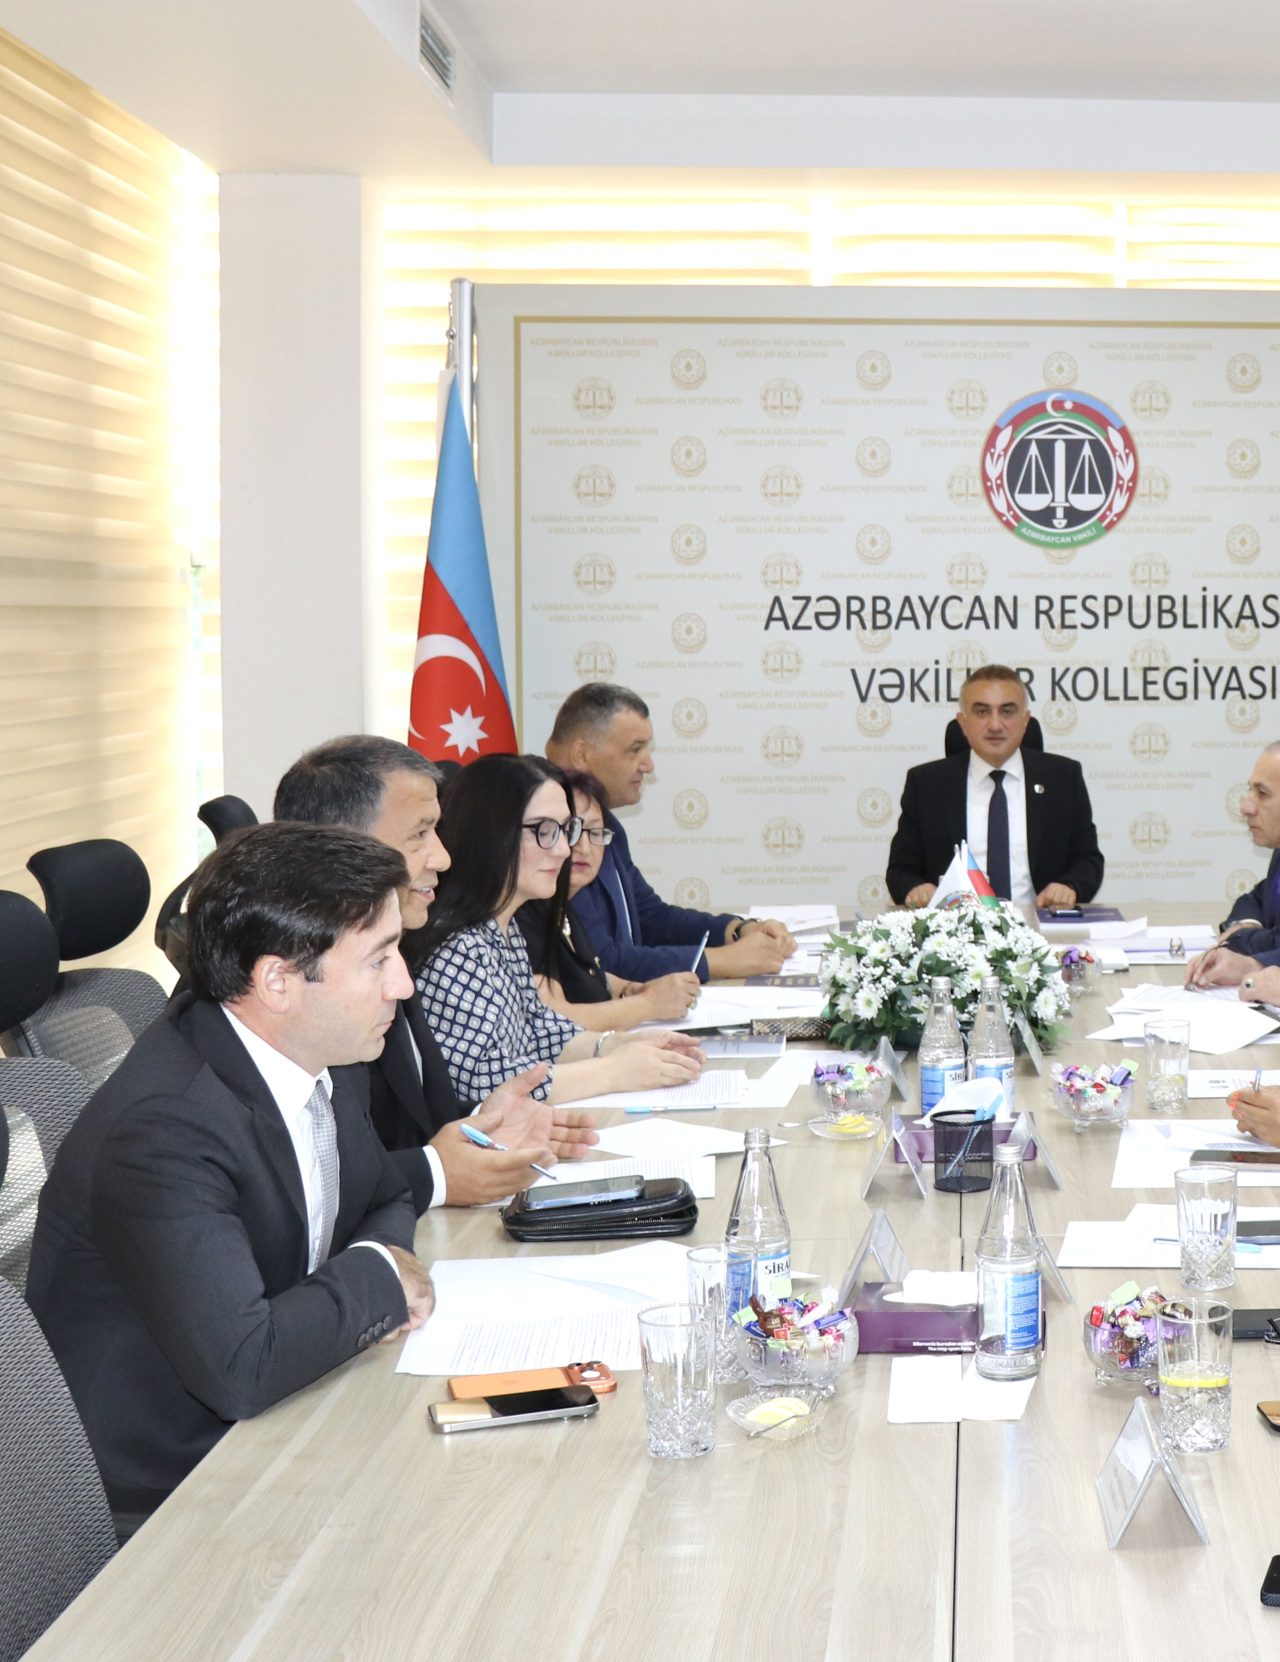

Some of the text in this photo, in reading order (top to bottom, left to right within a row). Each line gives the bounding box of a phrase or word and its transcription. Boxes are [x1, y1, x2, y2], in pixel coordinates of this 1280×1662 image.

[763, 595, 1018, 632] AZƏRBAYCAN
[850, 658, 1278, 704] VƏKİLR KOLLEGİYASI
